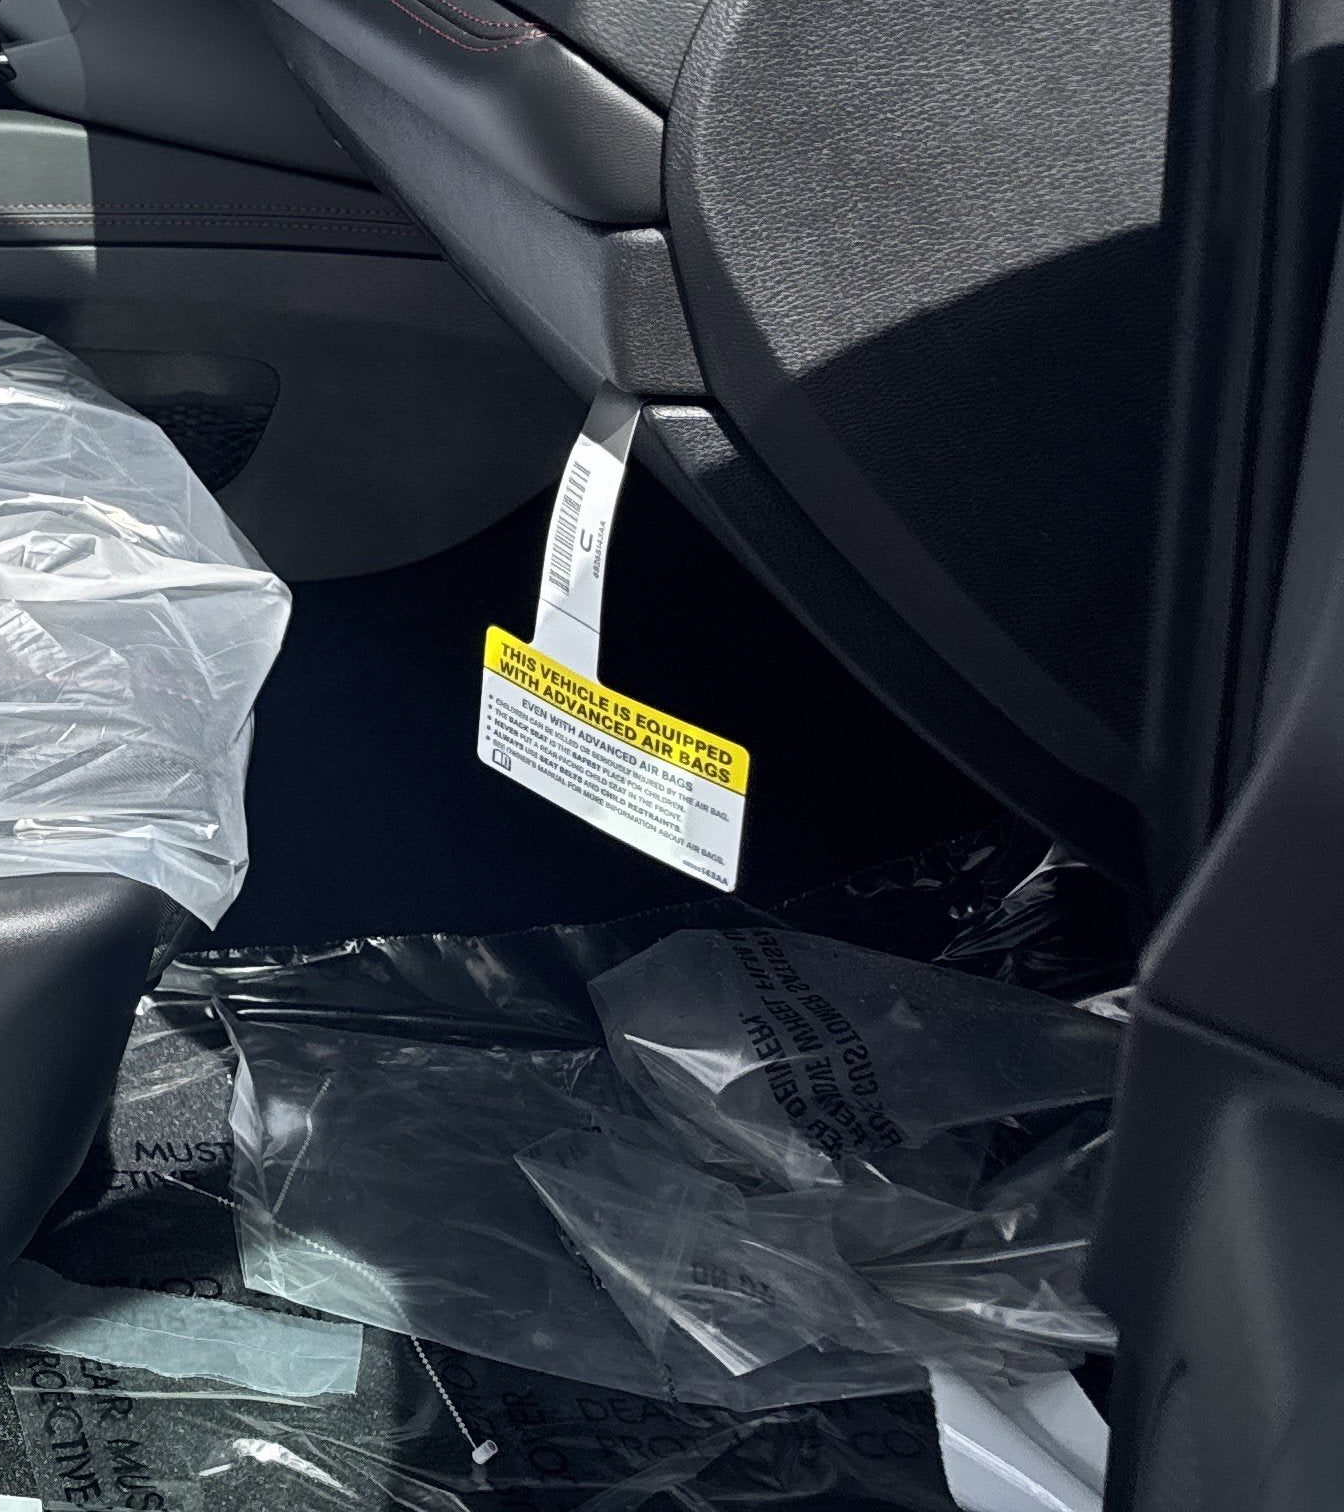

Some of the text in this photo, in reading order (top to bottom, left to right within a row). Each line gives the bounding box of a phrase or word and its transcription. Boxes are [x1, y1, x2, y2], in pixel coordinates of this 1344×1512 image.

[494, 706, 508, 721] THE
[508, 714, 529, 733] BACK
[529, 726, 548, 744] SEAT
[498, 657, 731, 785] WITH ADVANCED AIR BAGS
[499, 641, 733, 768] THIS VEHICLE IS EQUIPPED
[492, 727, 524, 751] ALWAYS
[538, 753, 558, 771] SEAT
[558, 764, 583, 785] BELTS
[600, 786, 626, 807] CHILD
[494, 717, 519, 738] NEVER
[518, 731, 533, 746] PUT
[638, 795, 653, 809] THE
[521, 697, 693, 793] EVEN WITH ADVANCED AIR BAGS
[677, 790, 694, 806] THE
[694, 798, 709, 813] AIR
[685, 840, 700, 854] AIR
[135, 1141, 235, 1163] MUST
[25, 1352, 103, 1503] ROECTIVE
[107, 1437, 165, 1512] MUS
